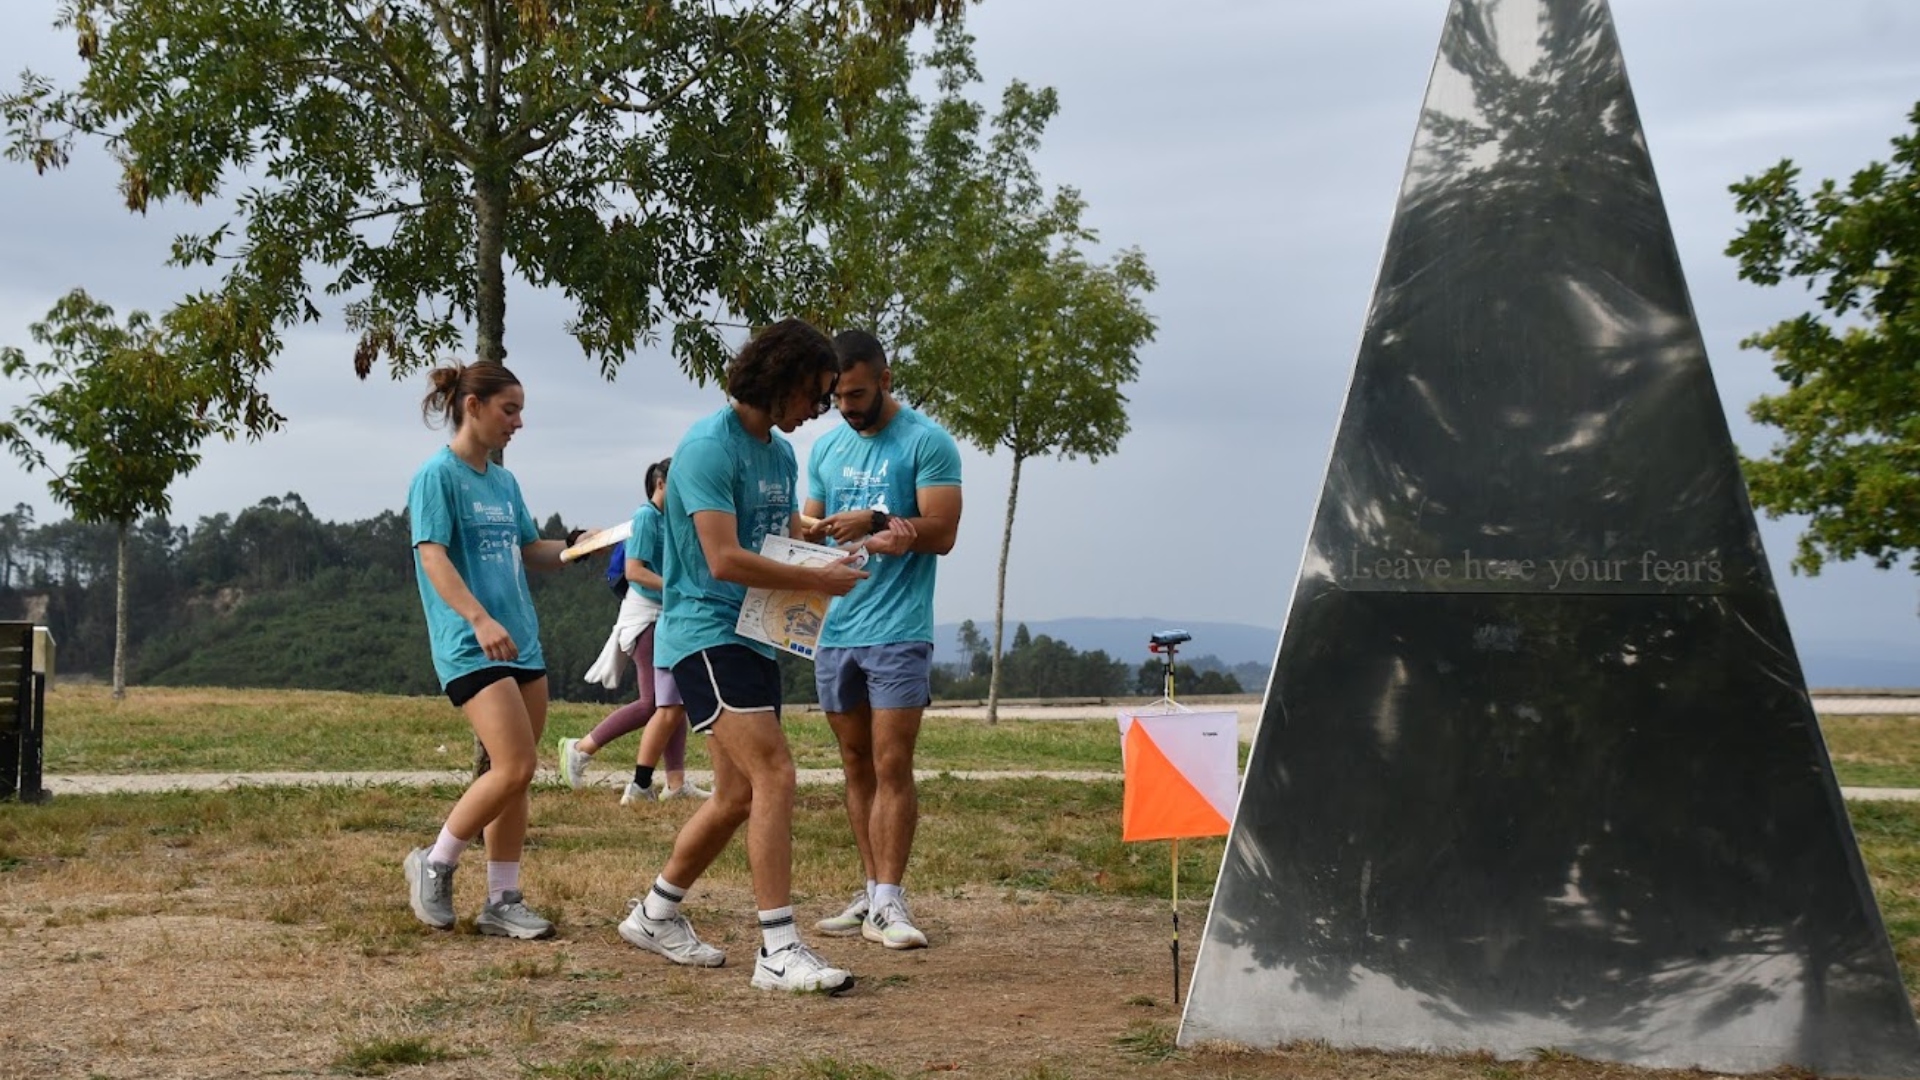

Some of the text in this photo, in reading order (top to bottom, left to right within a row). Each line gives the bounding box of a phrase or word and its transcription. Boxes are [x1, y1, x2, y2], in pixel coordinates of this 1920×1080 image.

[1350, 548, 1724, 590] Leave here your fears
